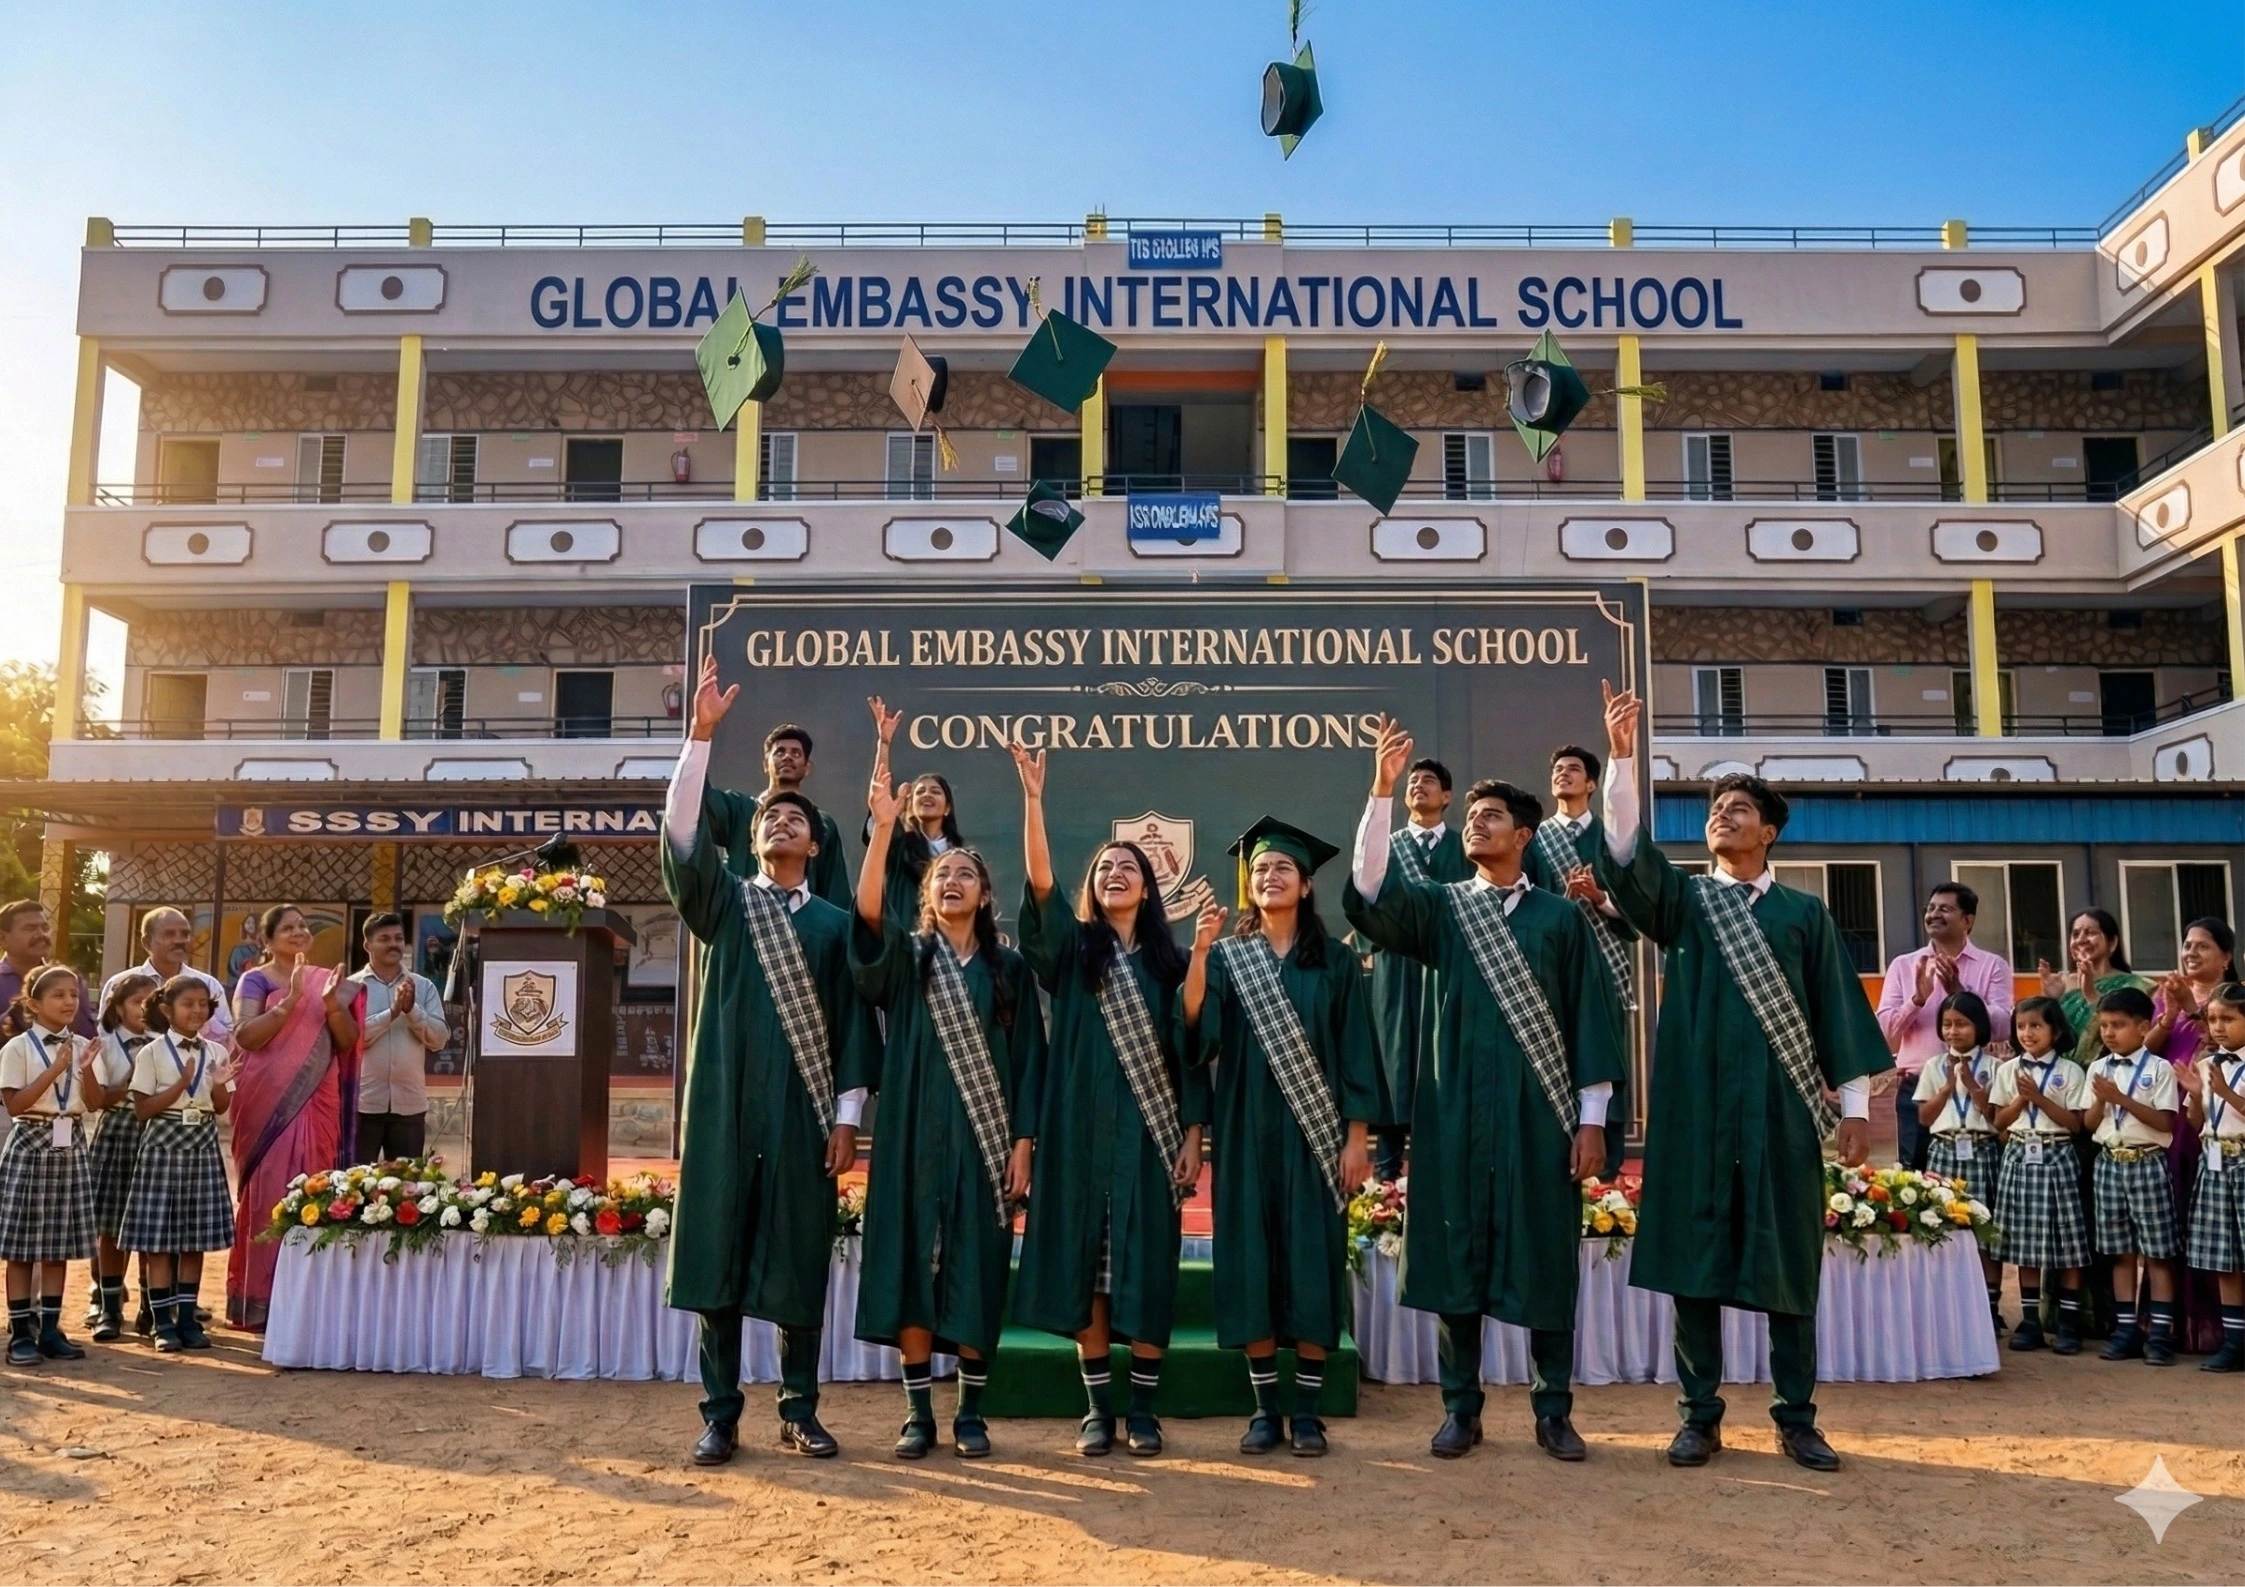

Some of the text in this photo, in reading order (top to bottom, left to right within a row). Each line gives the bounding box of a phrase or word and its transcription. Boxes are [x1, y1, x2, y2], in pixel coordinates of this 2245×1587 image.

[777, 275, 1040, 329] EMBASSY
[1064, 276, 1497, 328] INTERNATIONAL
[1518, 276, 1742, 329] SCHOOL
[746, 628, 1589, 667] GLOBAL EMBASSY INTERNATIONAL SCHOOL
[909, 713, 1381, 750] CONGRATULATIONS
[287, 810, 443, 833] SSSY
